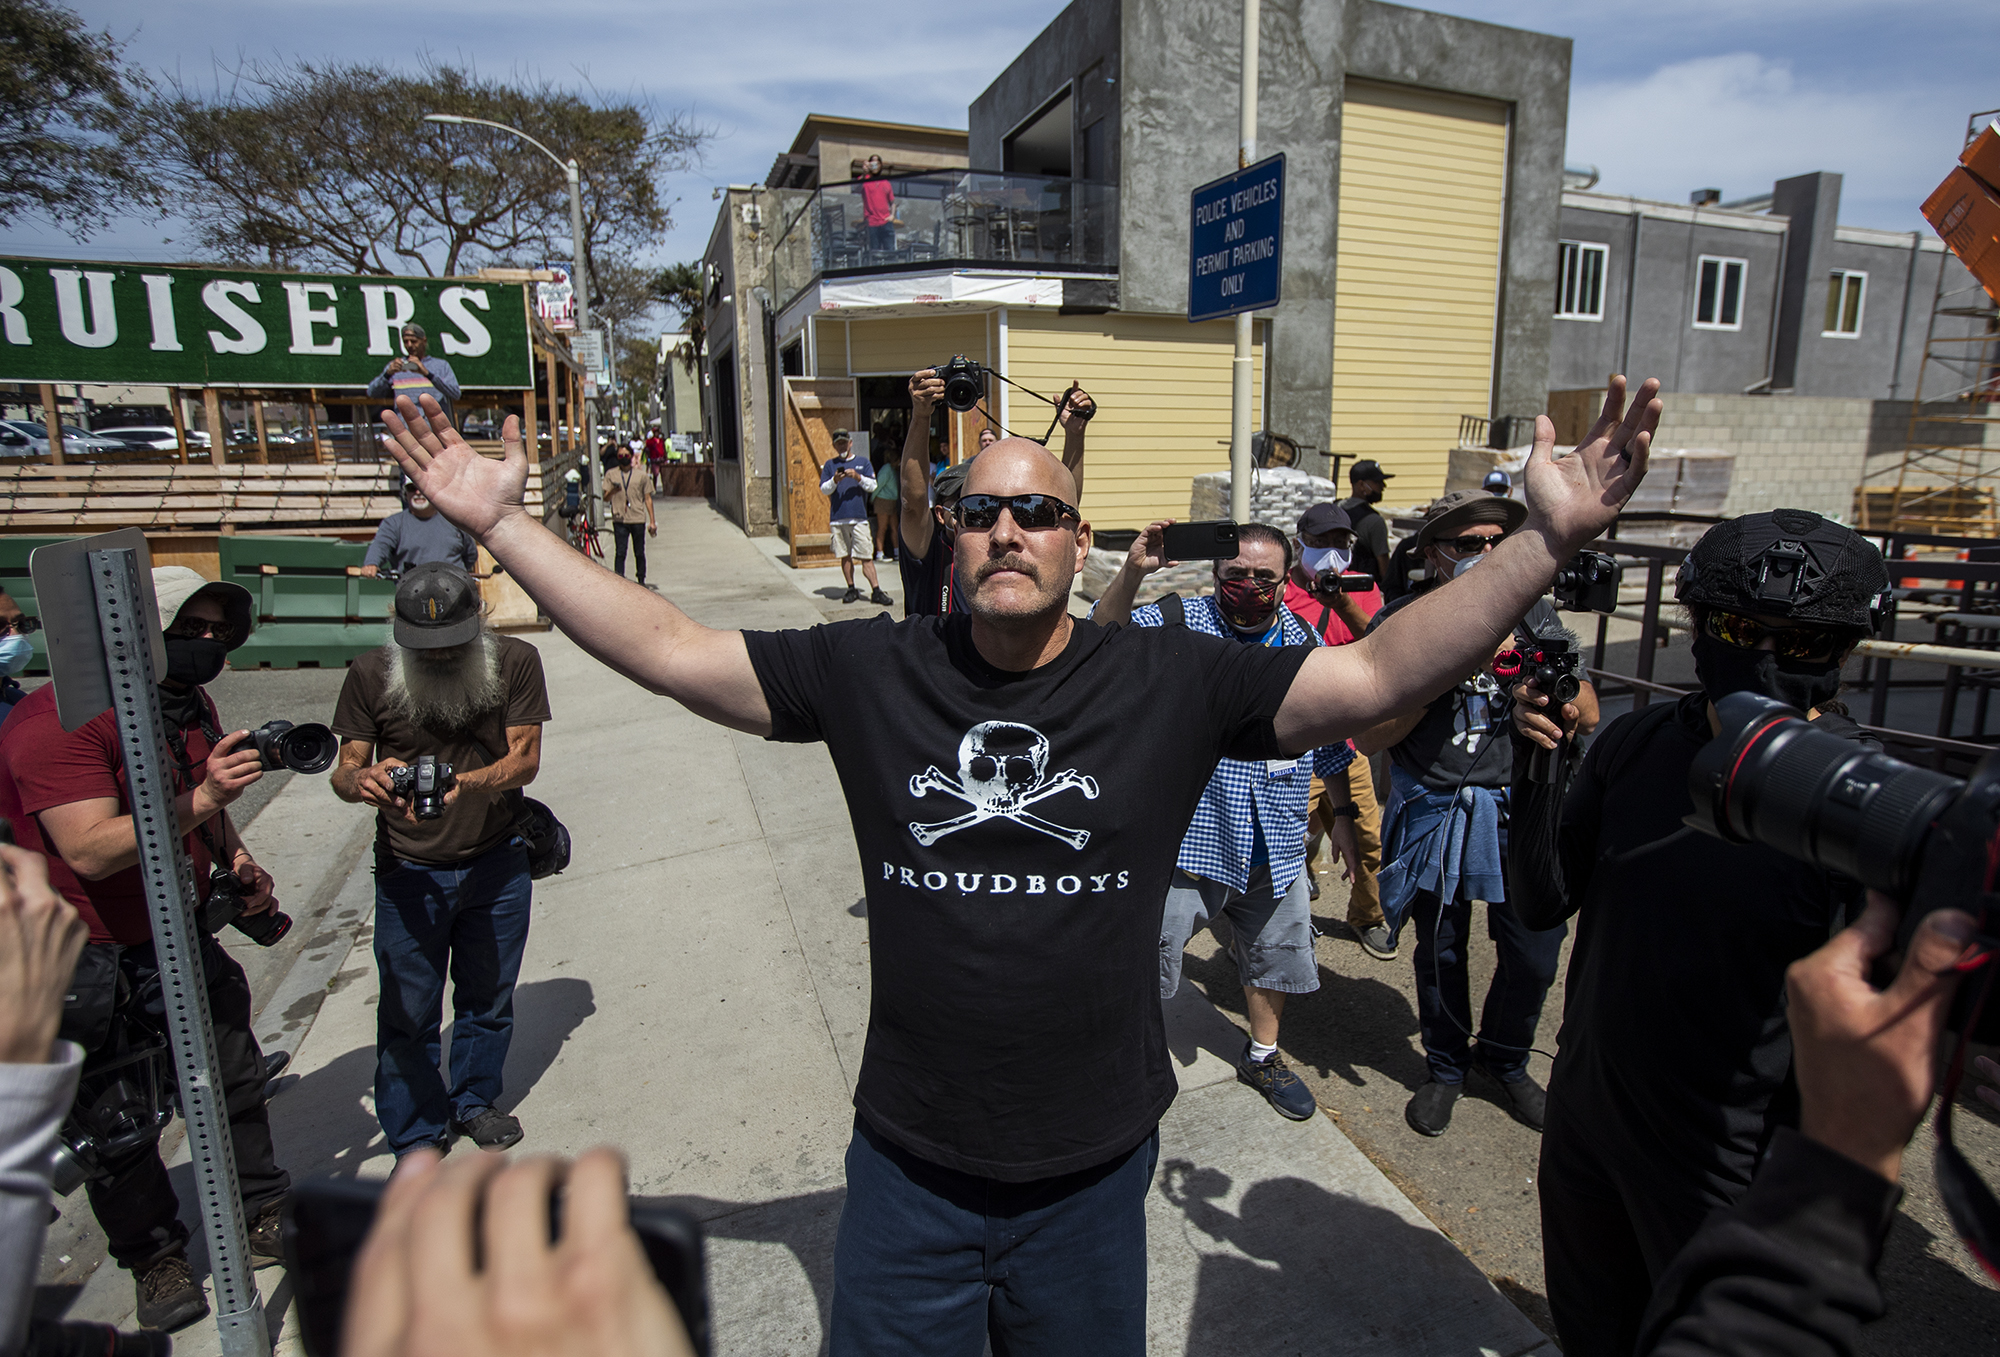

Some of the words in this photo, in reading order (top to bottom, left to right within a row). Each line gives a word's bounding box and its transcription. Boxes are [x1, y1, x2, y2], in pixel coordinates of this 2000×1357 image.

[1196, 197, 1228, 227] POLICE
[1230, 178, 1277, 214] VEHICLES
[1224, 218, 1245, 243] AND
[1196, 249, 1230, 277] PERMIT
[1232, 235, 1275, 267] PARKING
[1220, 272, 1246, 297] ONLY
[941, 585, 949, 612] Canon
[1273, 769, 1293, 777] MEDIA
